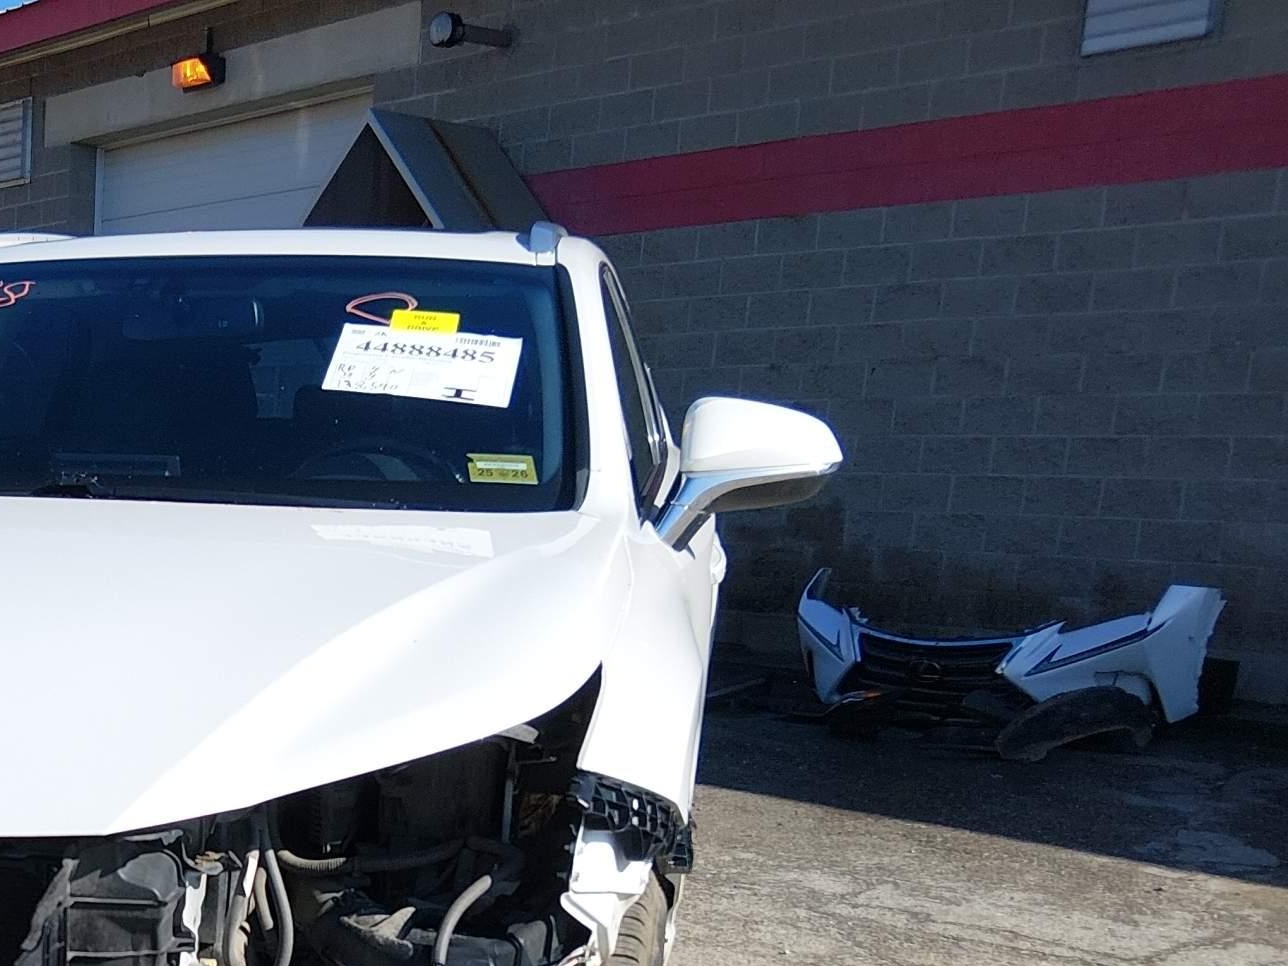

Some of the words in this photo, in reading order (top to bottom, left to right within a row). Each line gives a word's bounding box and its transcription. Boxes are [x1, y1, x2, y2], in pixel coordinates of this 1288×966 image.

[356, 340, 496, 364] 44888485
[478, 468, 494, 477] 25
[511, 470, 529, 479] 26
